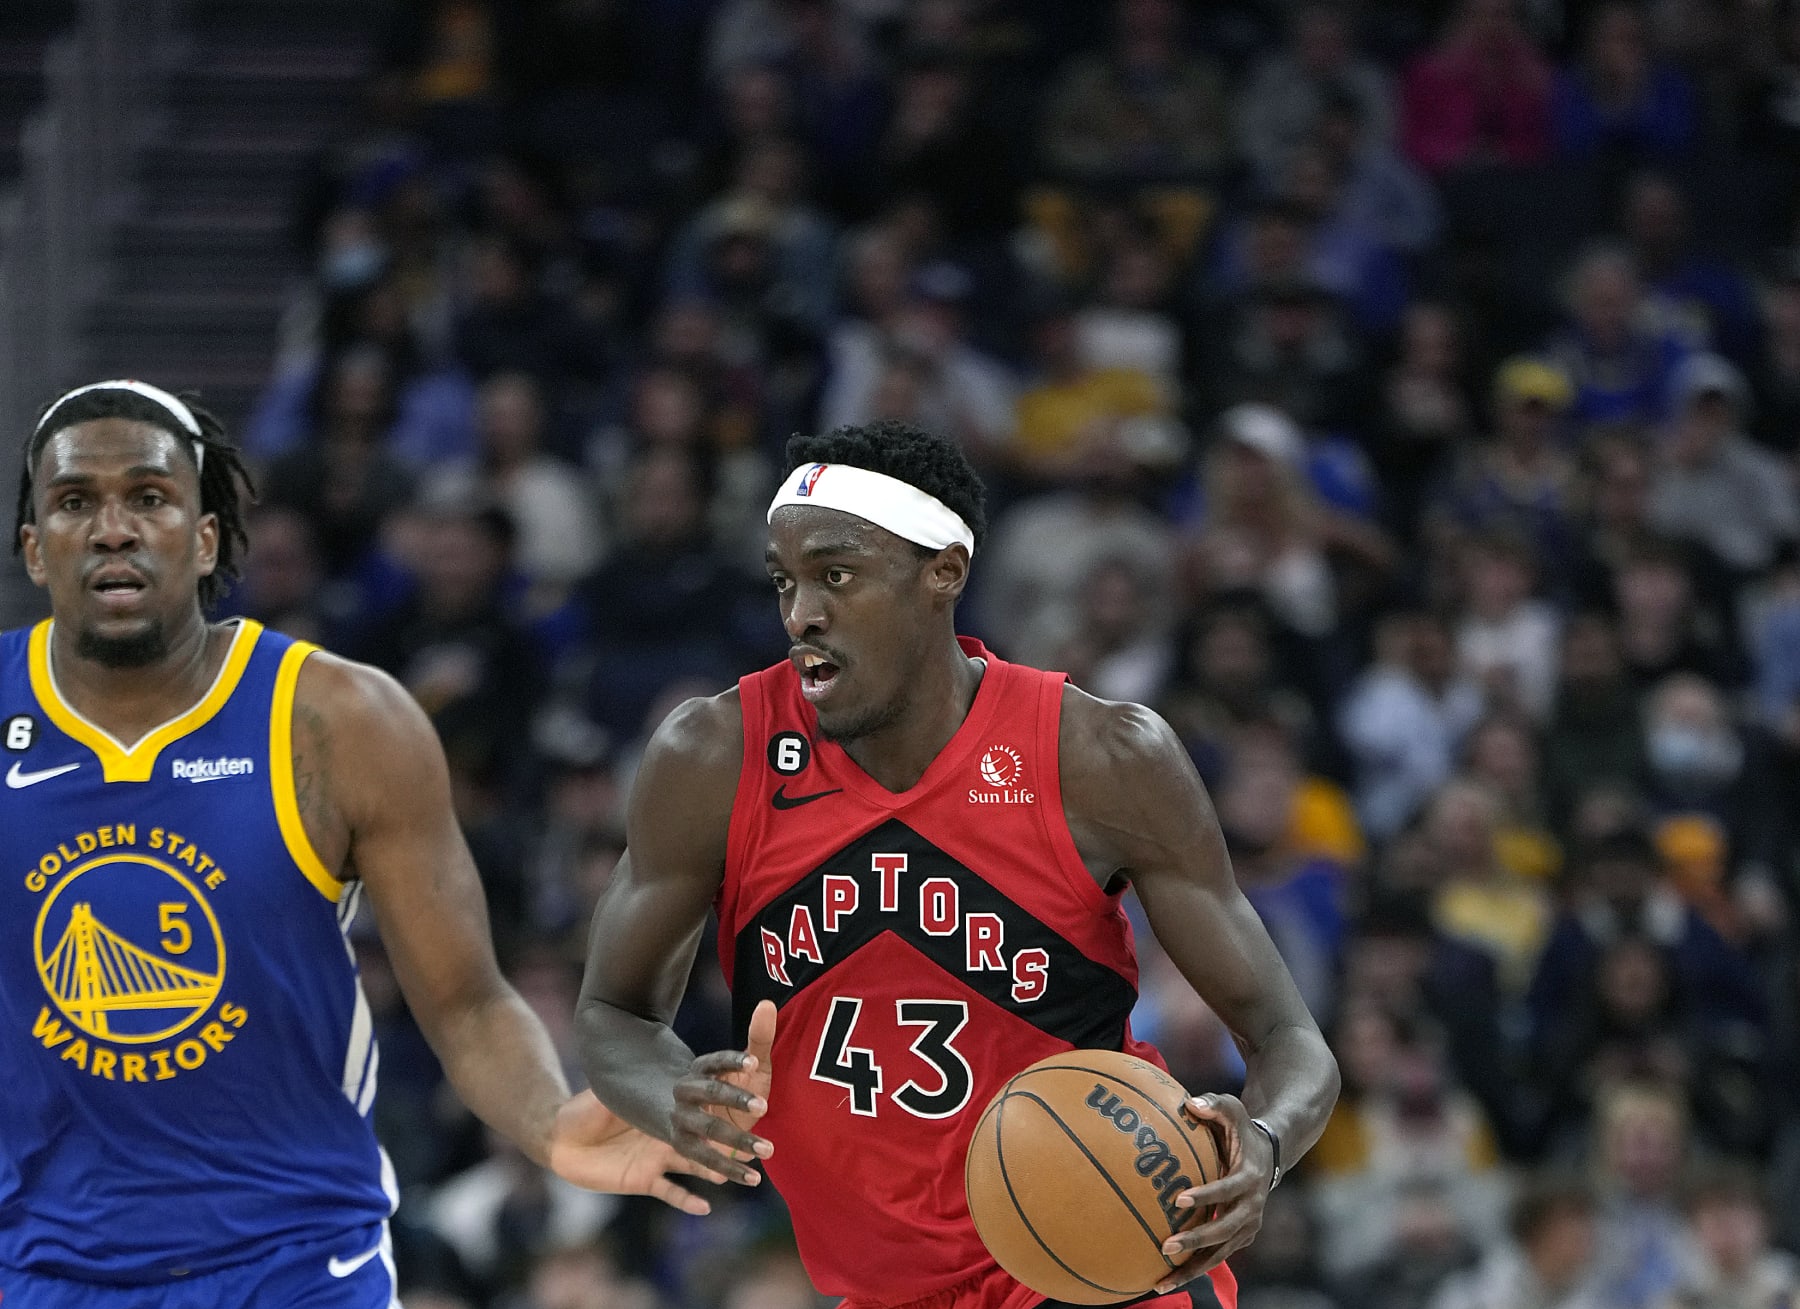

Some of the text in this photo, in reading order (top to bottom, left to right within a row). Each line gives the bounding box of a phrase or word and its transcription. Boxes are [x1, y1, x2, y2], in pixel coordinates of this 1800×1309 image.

[6, 717, 33, 750] 6
[777, 738, 801, 770] 6
[172, 757, 254, 782] Rakuten
[968, 788, 1035, 804] Sun Life
[24, 823, 227, 893] GOLDEN STATE
[158, 902, 192, 955] 5
[760, 853, 1050, 1004] RAPTORS
[31, 1002, 249, 1083] WARRIORS
[809, 996, 974, 1120] 43
[1084, 1083, 1198, 1236] Wilson
